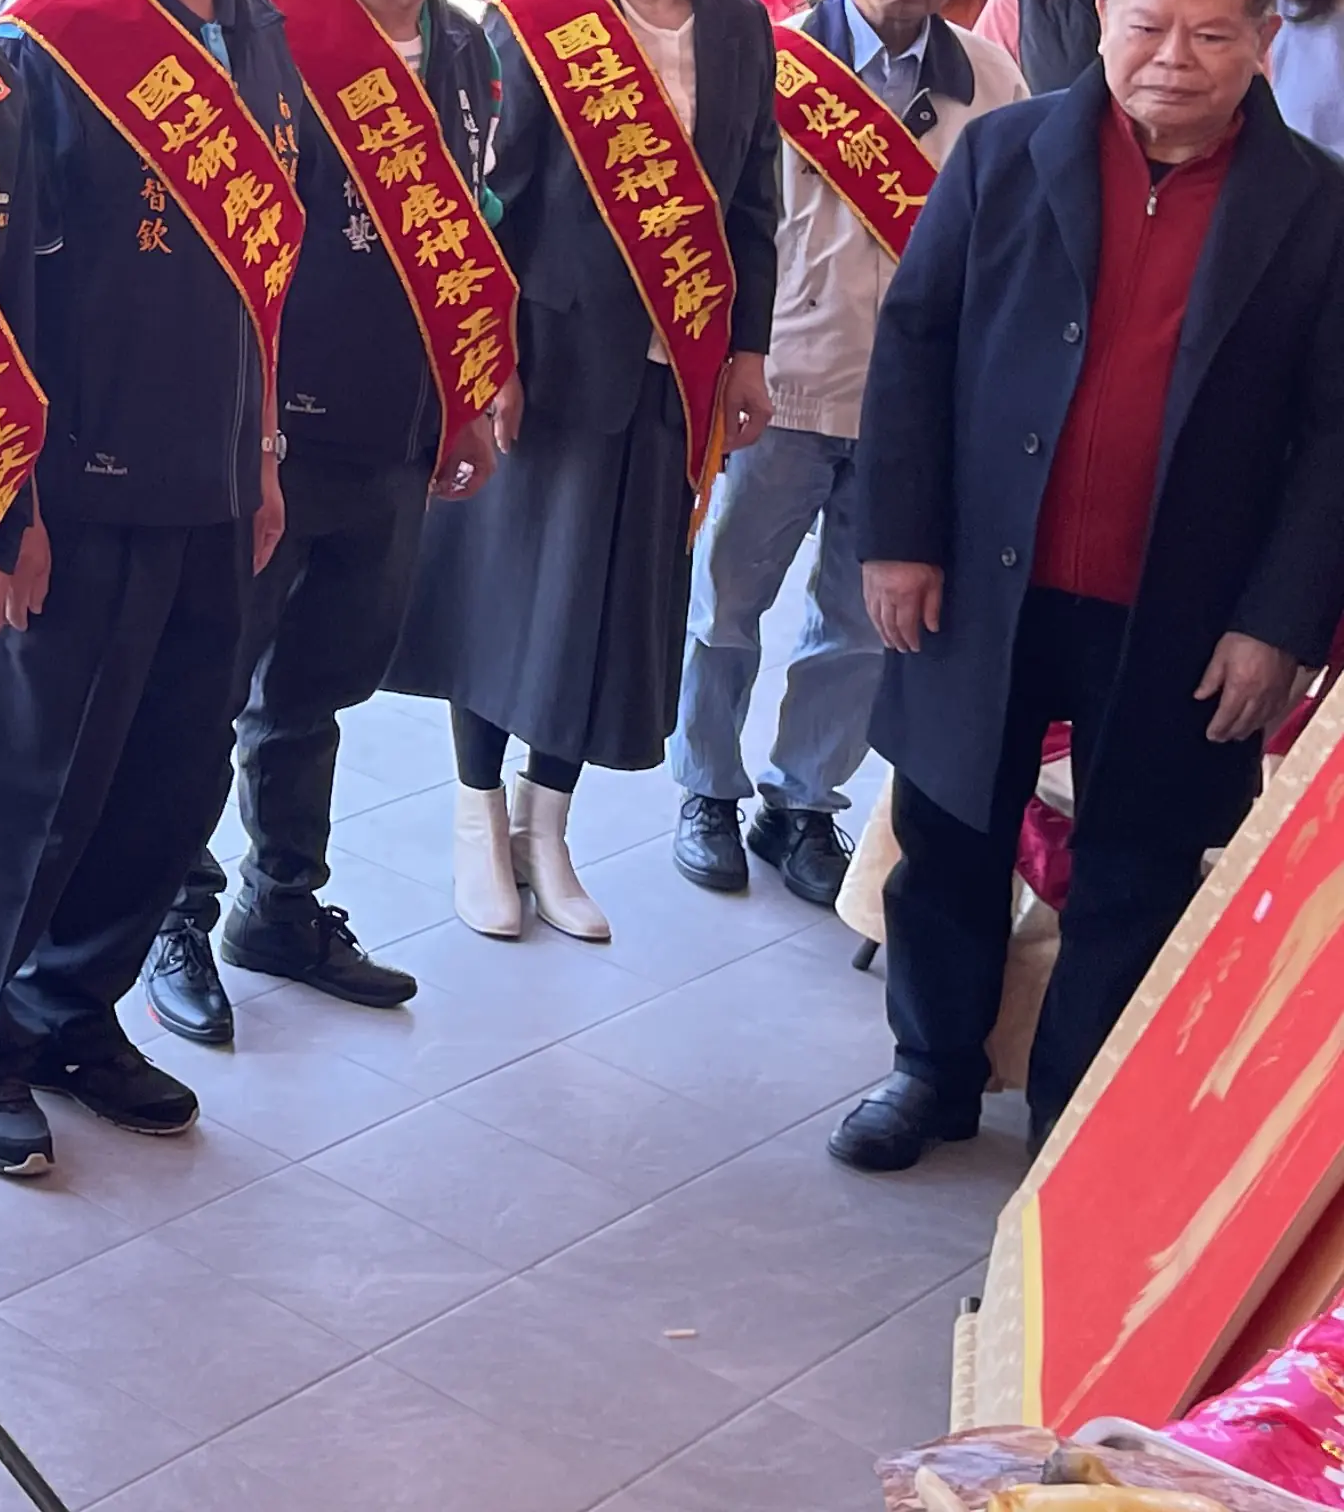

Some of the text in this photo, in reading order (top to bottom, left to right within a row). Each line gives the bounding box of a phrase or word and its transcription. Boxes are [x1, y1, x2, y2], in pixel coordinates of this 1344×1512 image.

[135, 152, 173, 255] 智欽
[335, 66, 507, 410] 國姓鄉鹿神祭正獻官
